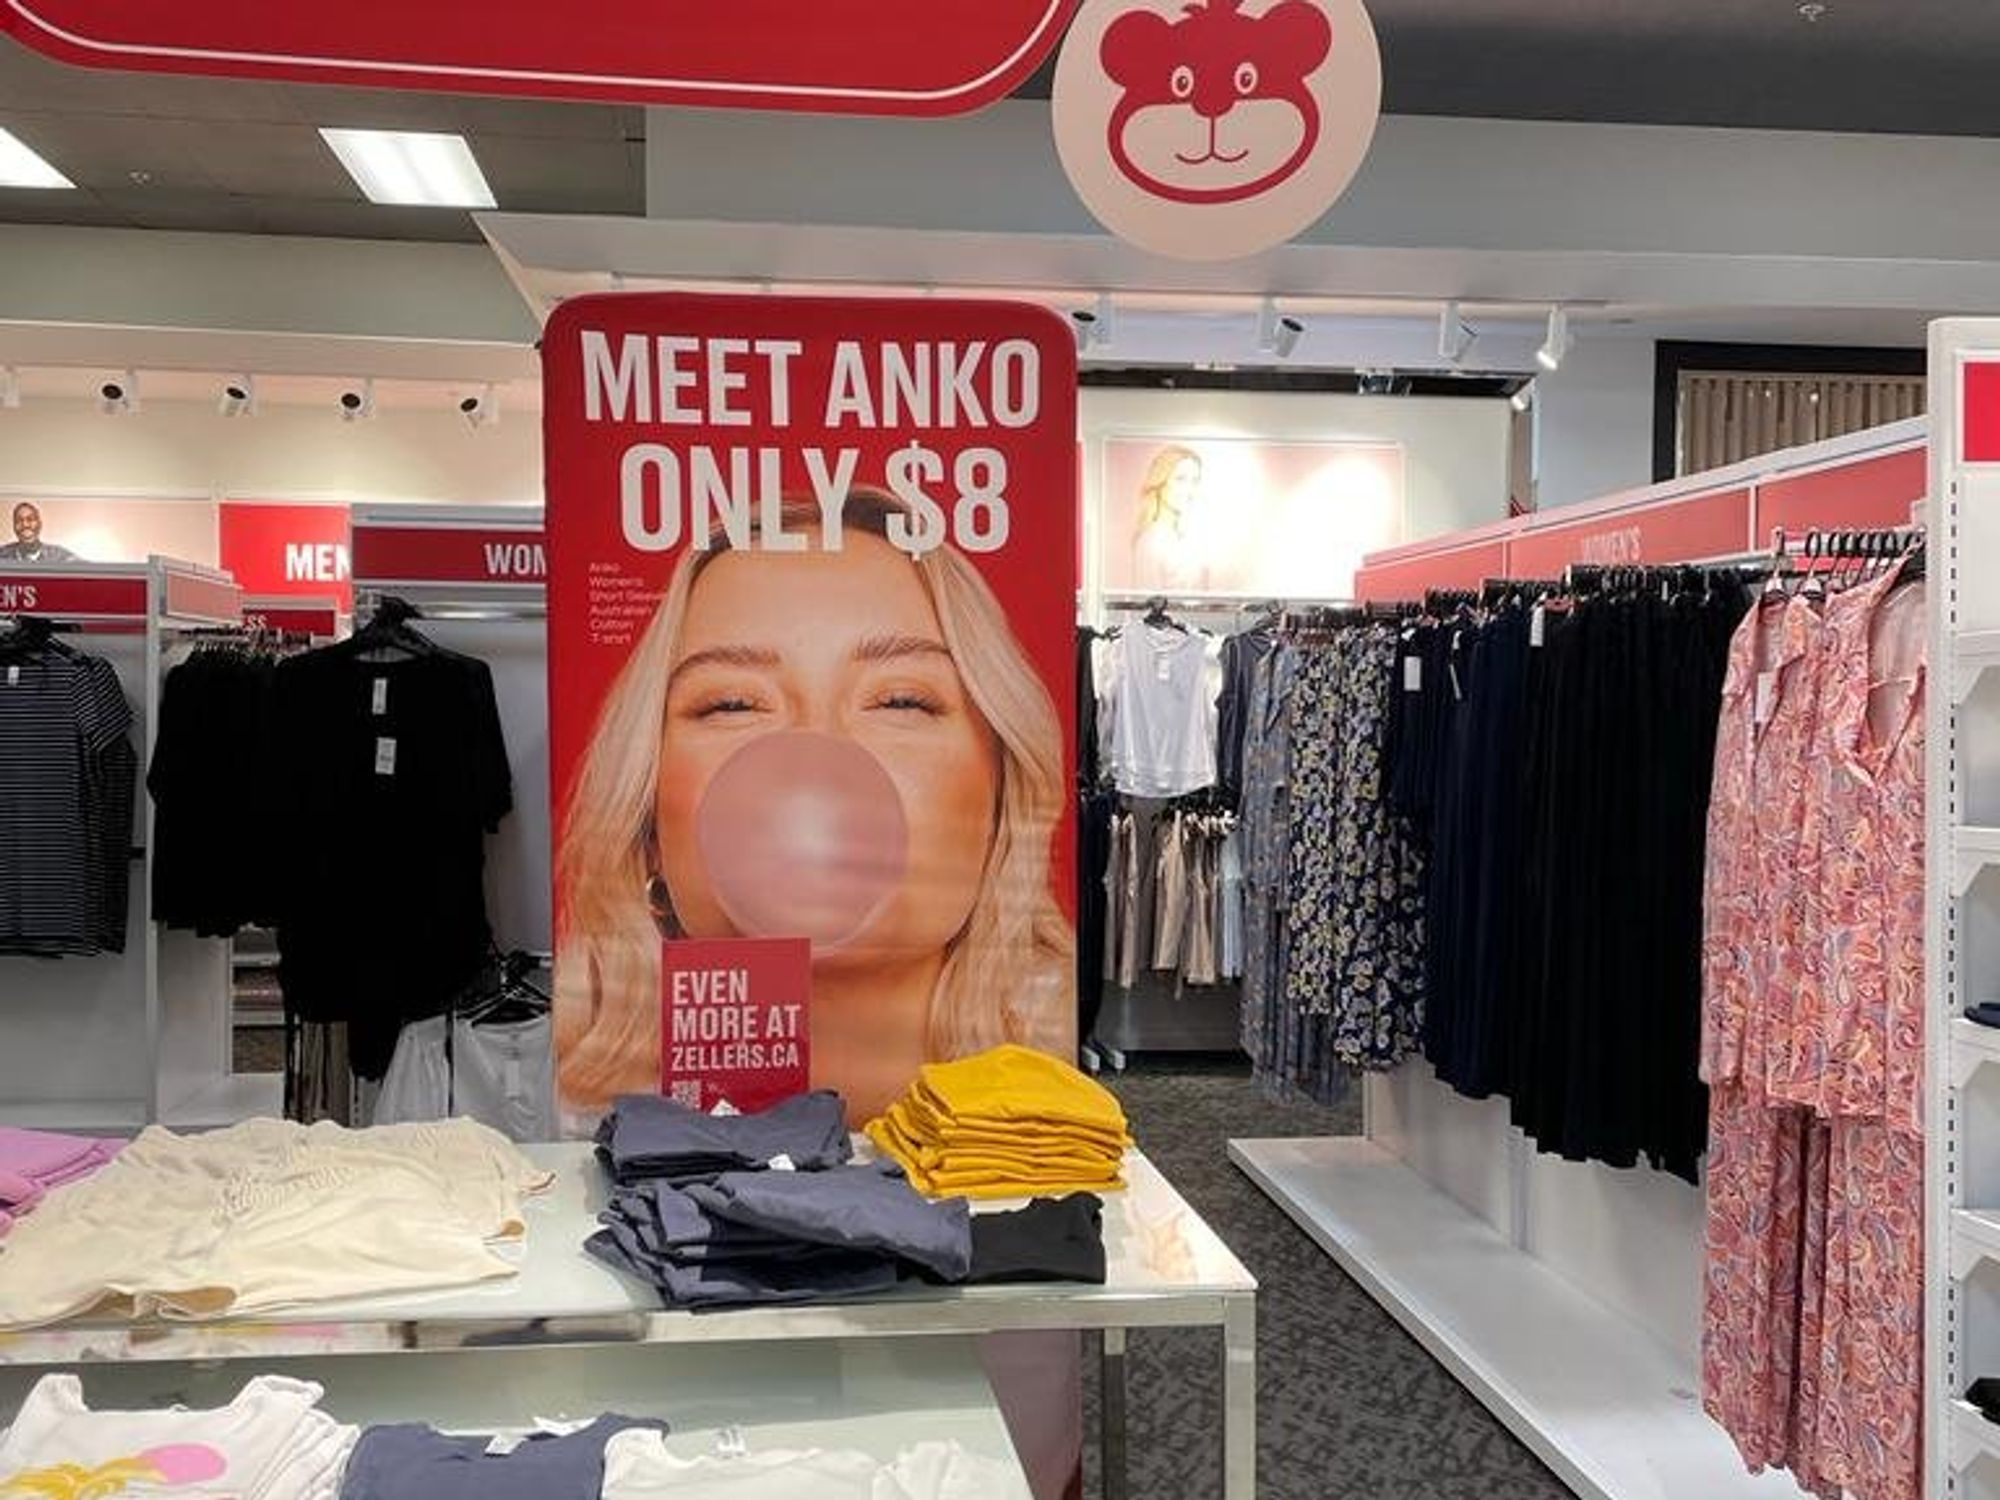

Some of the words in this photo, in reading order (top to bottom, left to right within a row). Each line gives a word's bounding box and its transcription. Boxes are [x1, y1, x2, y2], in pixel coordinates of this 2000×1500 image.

[580, 330, 803, 427] MEET
[824, 338, 1041, 429] ANKO
[619, 443, 860, 552] ONLY
[885, 439, 1009, 561] $8
[671, 969, 749, 1004] EVEN
[671, 1005, 759, 1043] MORE
[765, 1004, 802, 1039] AT
[671, 1042, 800, 1072] ZELLERS.CA
